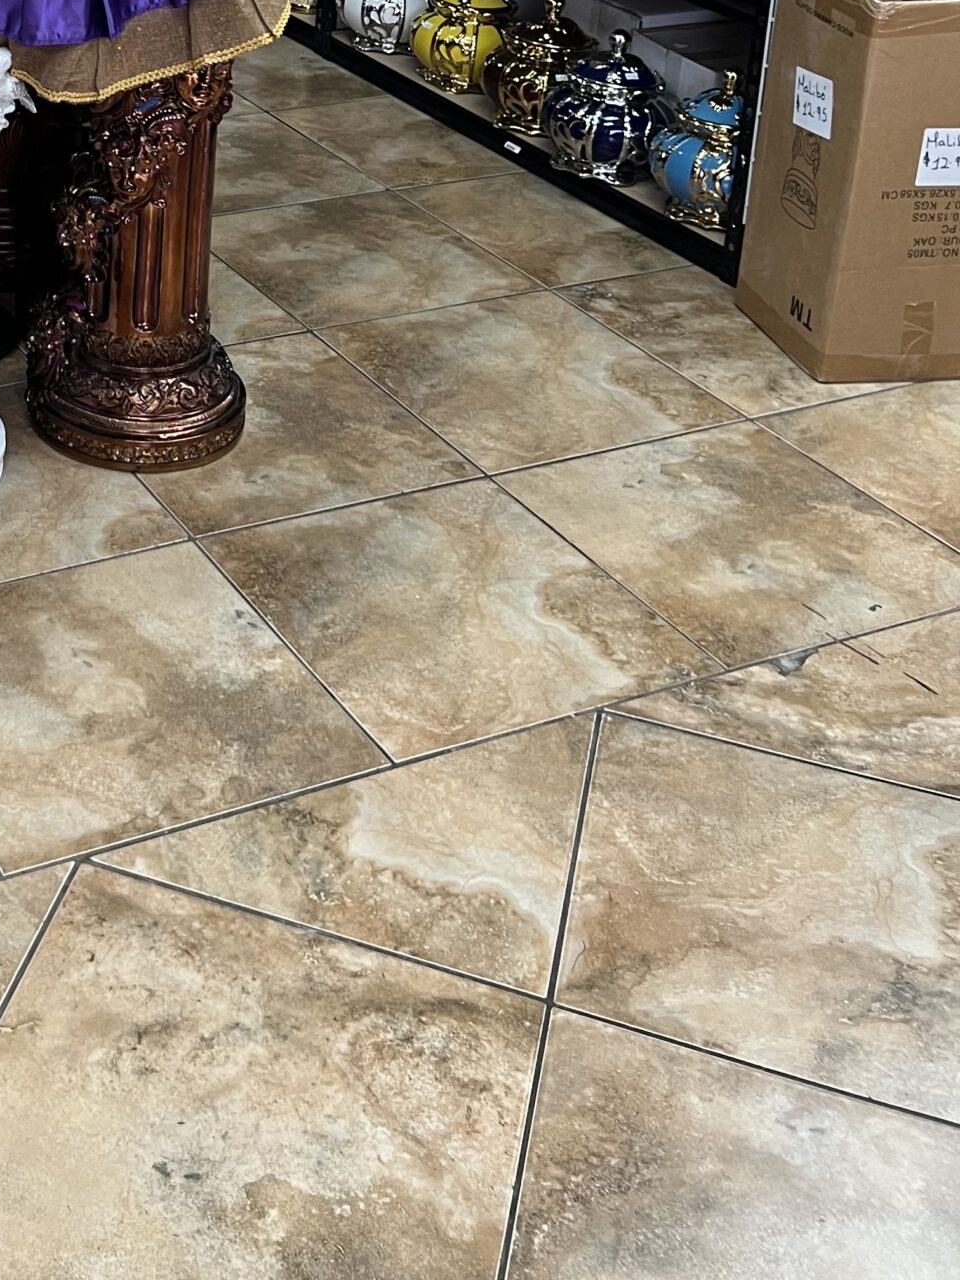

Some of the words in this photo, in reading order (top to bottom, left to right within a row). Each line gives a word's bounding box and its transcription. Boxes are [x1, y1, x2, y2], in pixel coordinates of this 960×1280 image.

[913, 201, 937, 210] KGS
[941, 224, 957, 234] PC
[913, 236, 937, 247] OAK
[790, 295, 812, 331] TM
